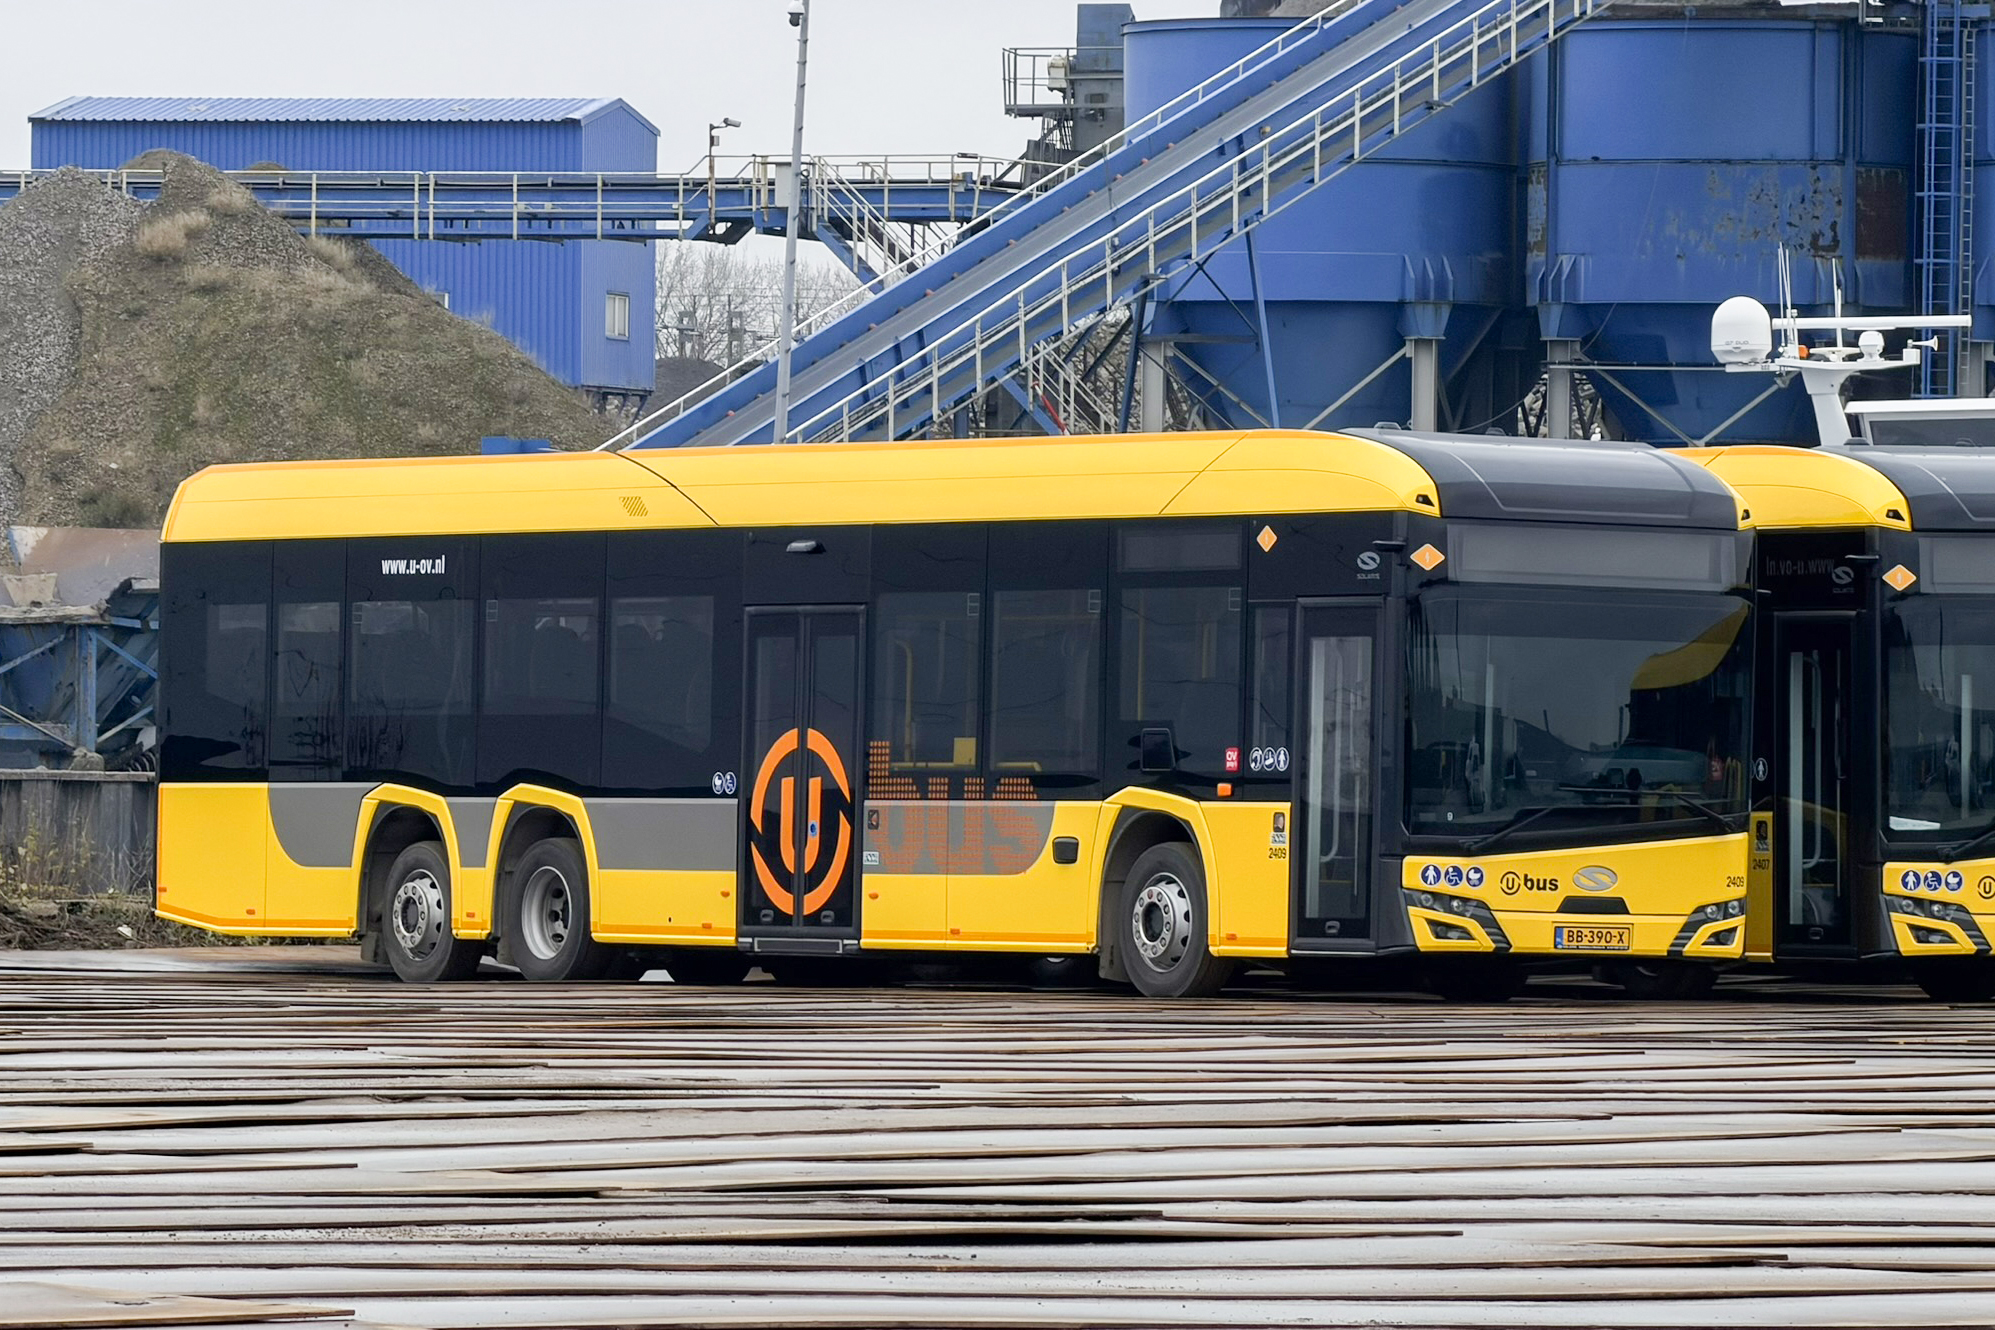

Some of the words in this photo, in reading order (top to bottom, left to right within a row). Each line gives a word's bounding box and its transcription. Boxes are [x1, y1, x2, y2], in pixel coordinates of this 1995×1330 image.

[381, 554, 446, 575] www.u-ov.nl
[868, 740, 1042, 874] bus
[1268, 847, 1287, 859] 2409
[1752, 858, 1770, 870] 2407
[1523, 873, 1559, 891] bus
[1726, 875, 1745, 887] 2409
[1566, 929, 1625, 944] BB-390-X
